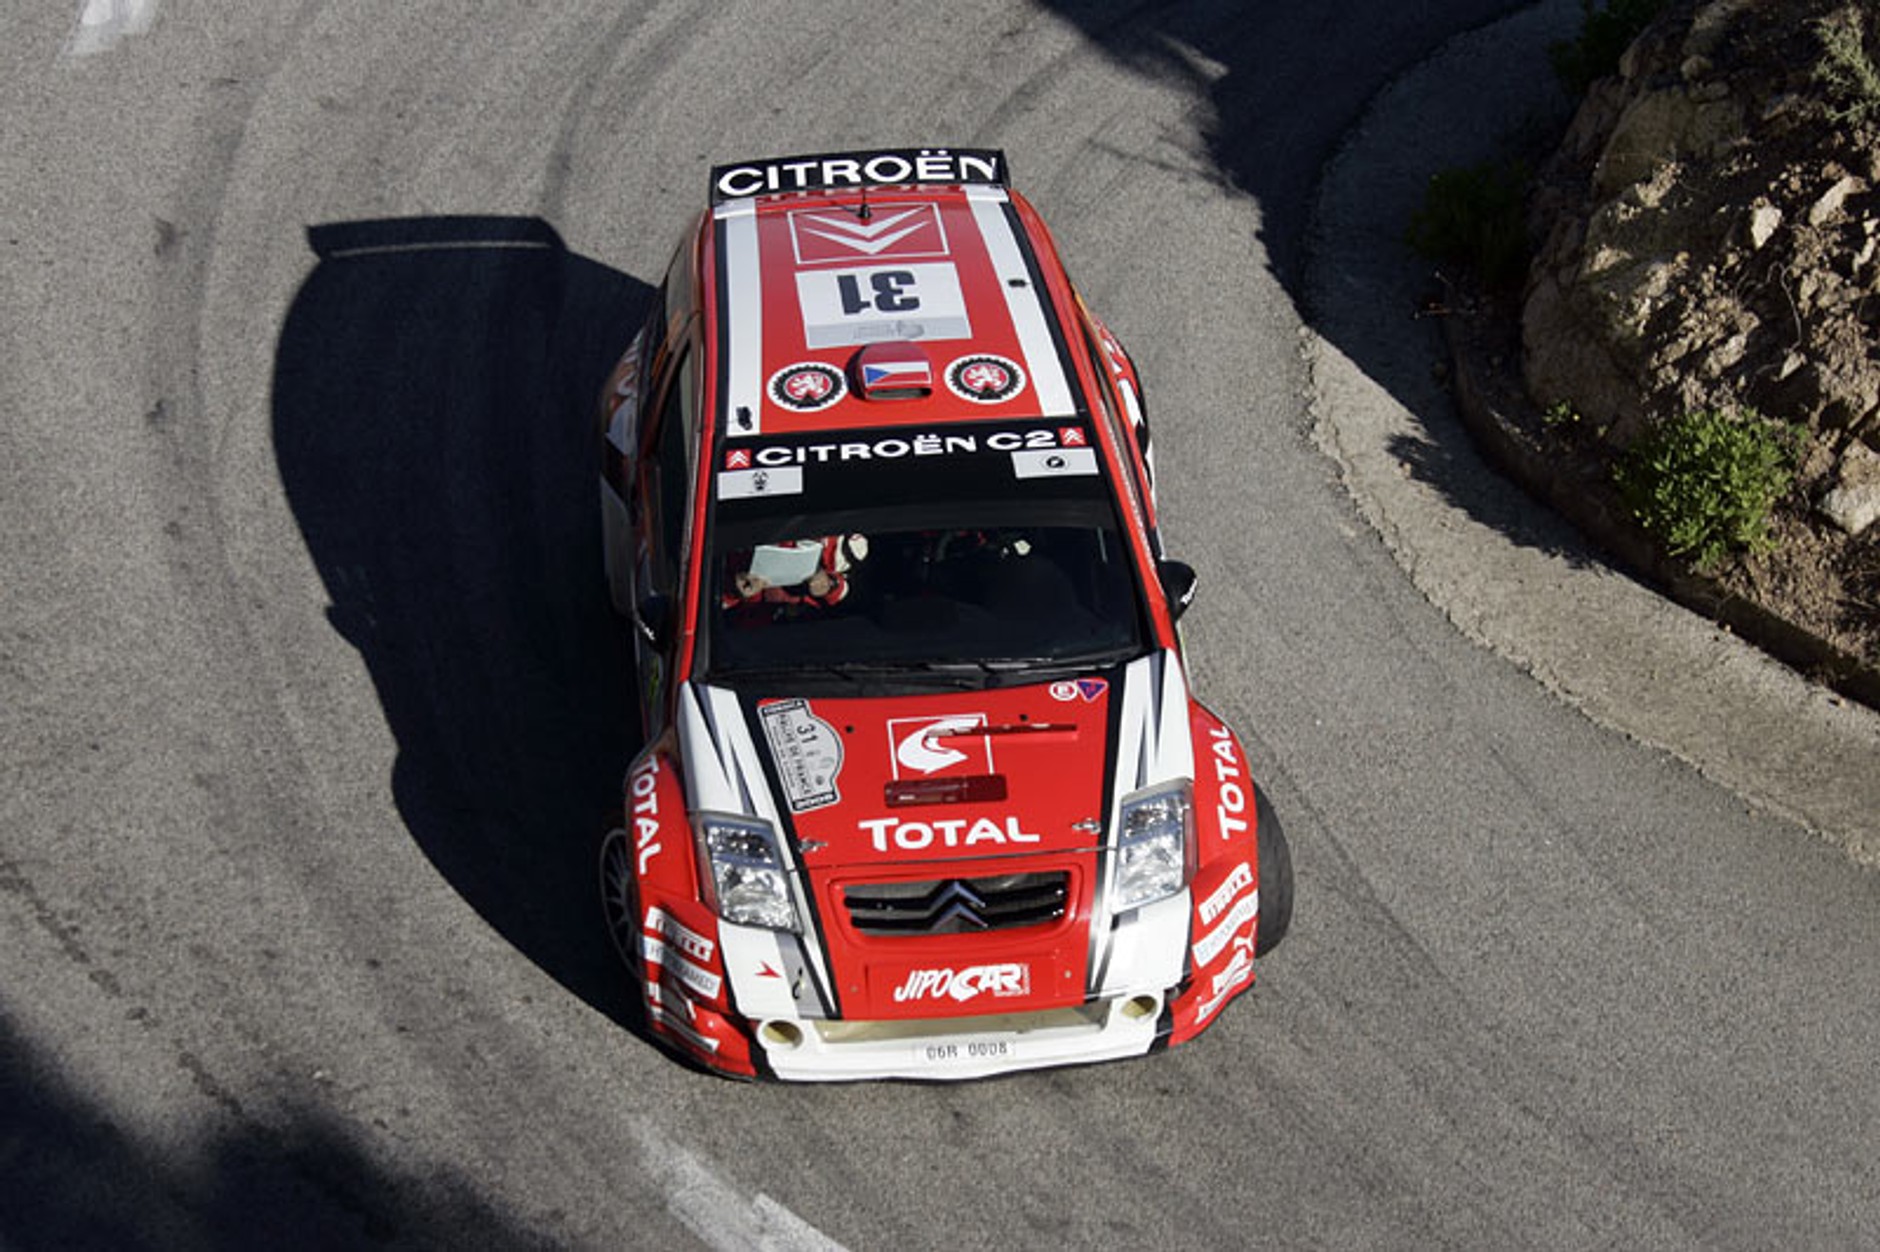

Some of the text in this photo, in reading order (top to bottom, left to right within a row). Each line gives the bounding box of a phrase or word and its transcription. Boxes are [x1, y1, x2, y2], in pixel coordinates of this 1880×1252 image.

[717, 149, 997, 196] CITROËN
[836, 270, 921, 316] 31
[755, 429, 1057, 465] CITROËN C2
[796, 722, 818, 745] 31
[1210, 726, 1248, 840] TOTAL
[632, 754, 661, 876] TOTAL
[858, 816, 1040, 852] TOTAL
